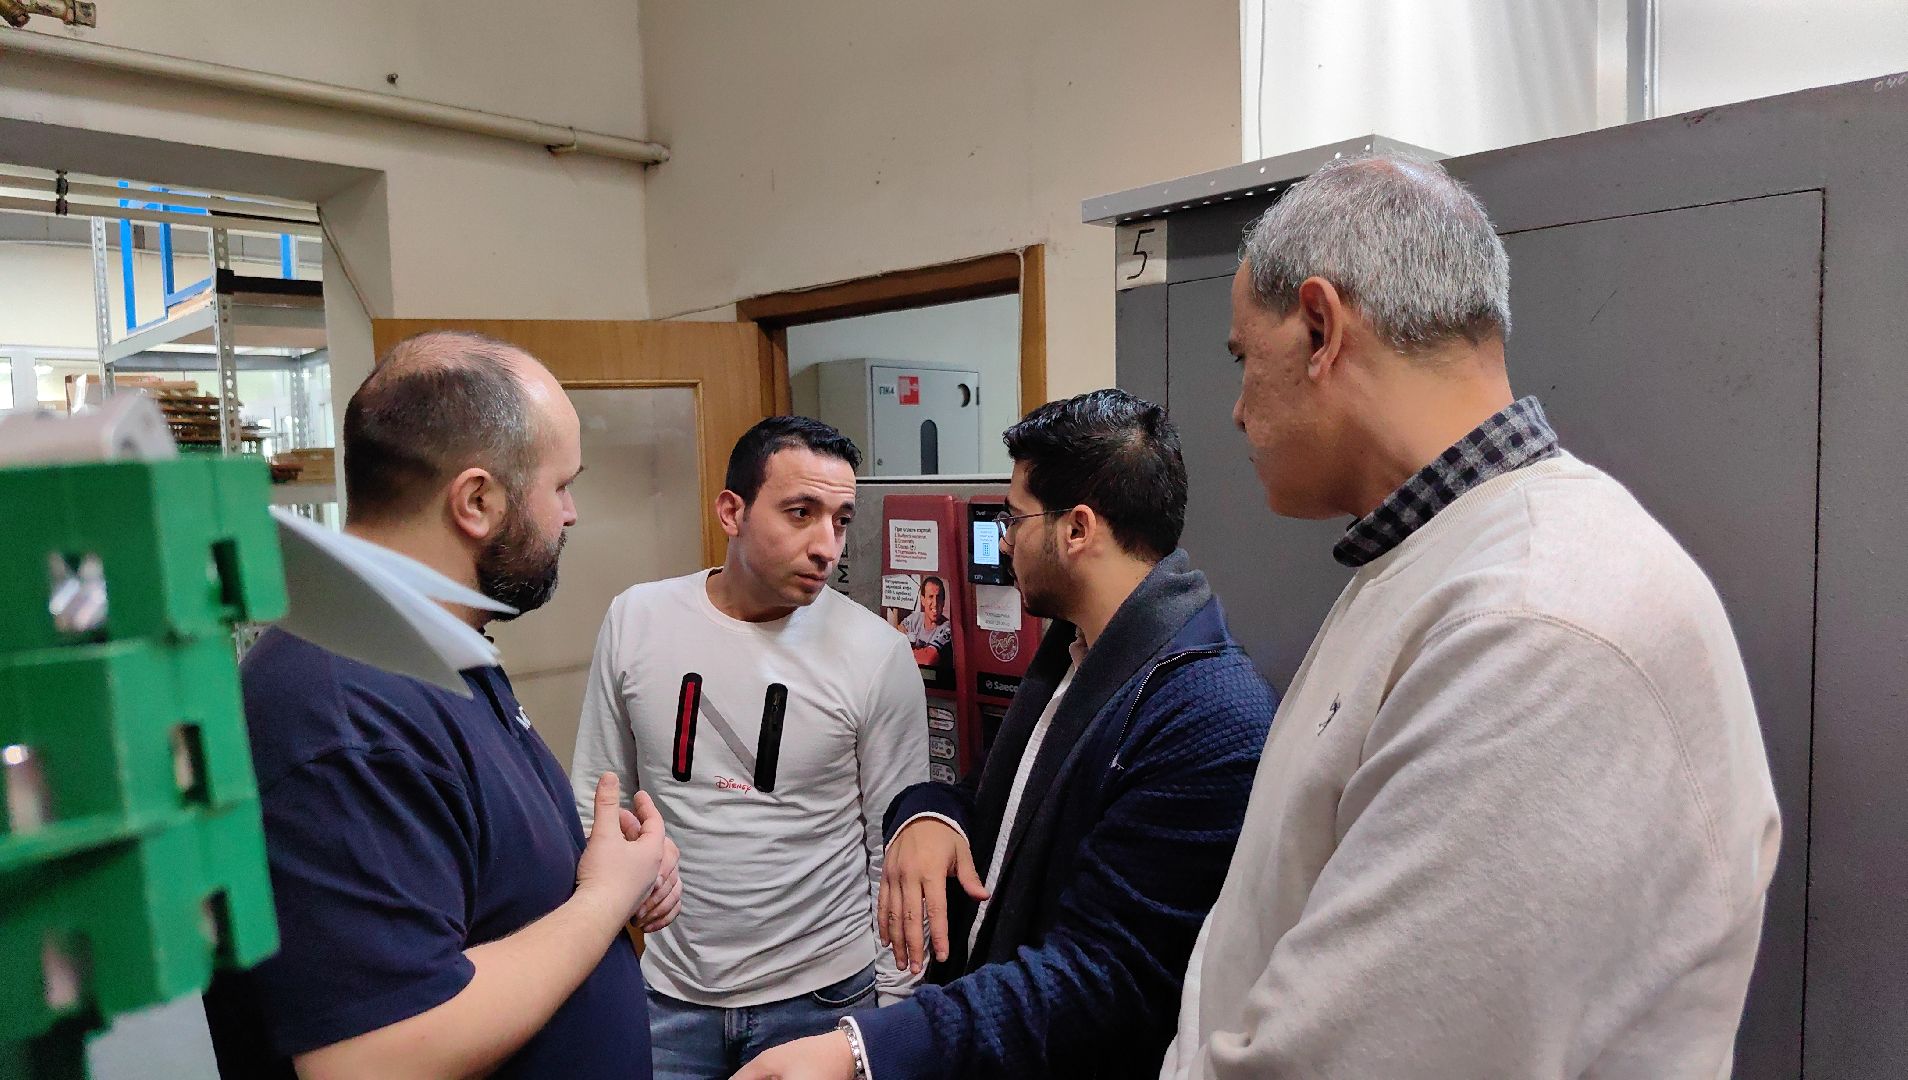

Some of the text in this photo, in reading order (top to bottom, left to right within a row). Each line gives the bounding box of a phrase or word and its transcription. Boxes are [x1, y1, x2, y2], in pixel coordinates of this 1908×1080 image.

[1127, 228, 1155, 280] 5
[993, 681, 1019, 693] Saeco
[715, 775, 752, 794] Disney
